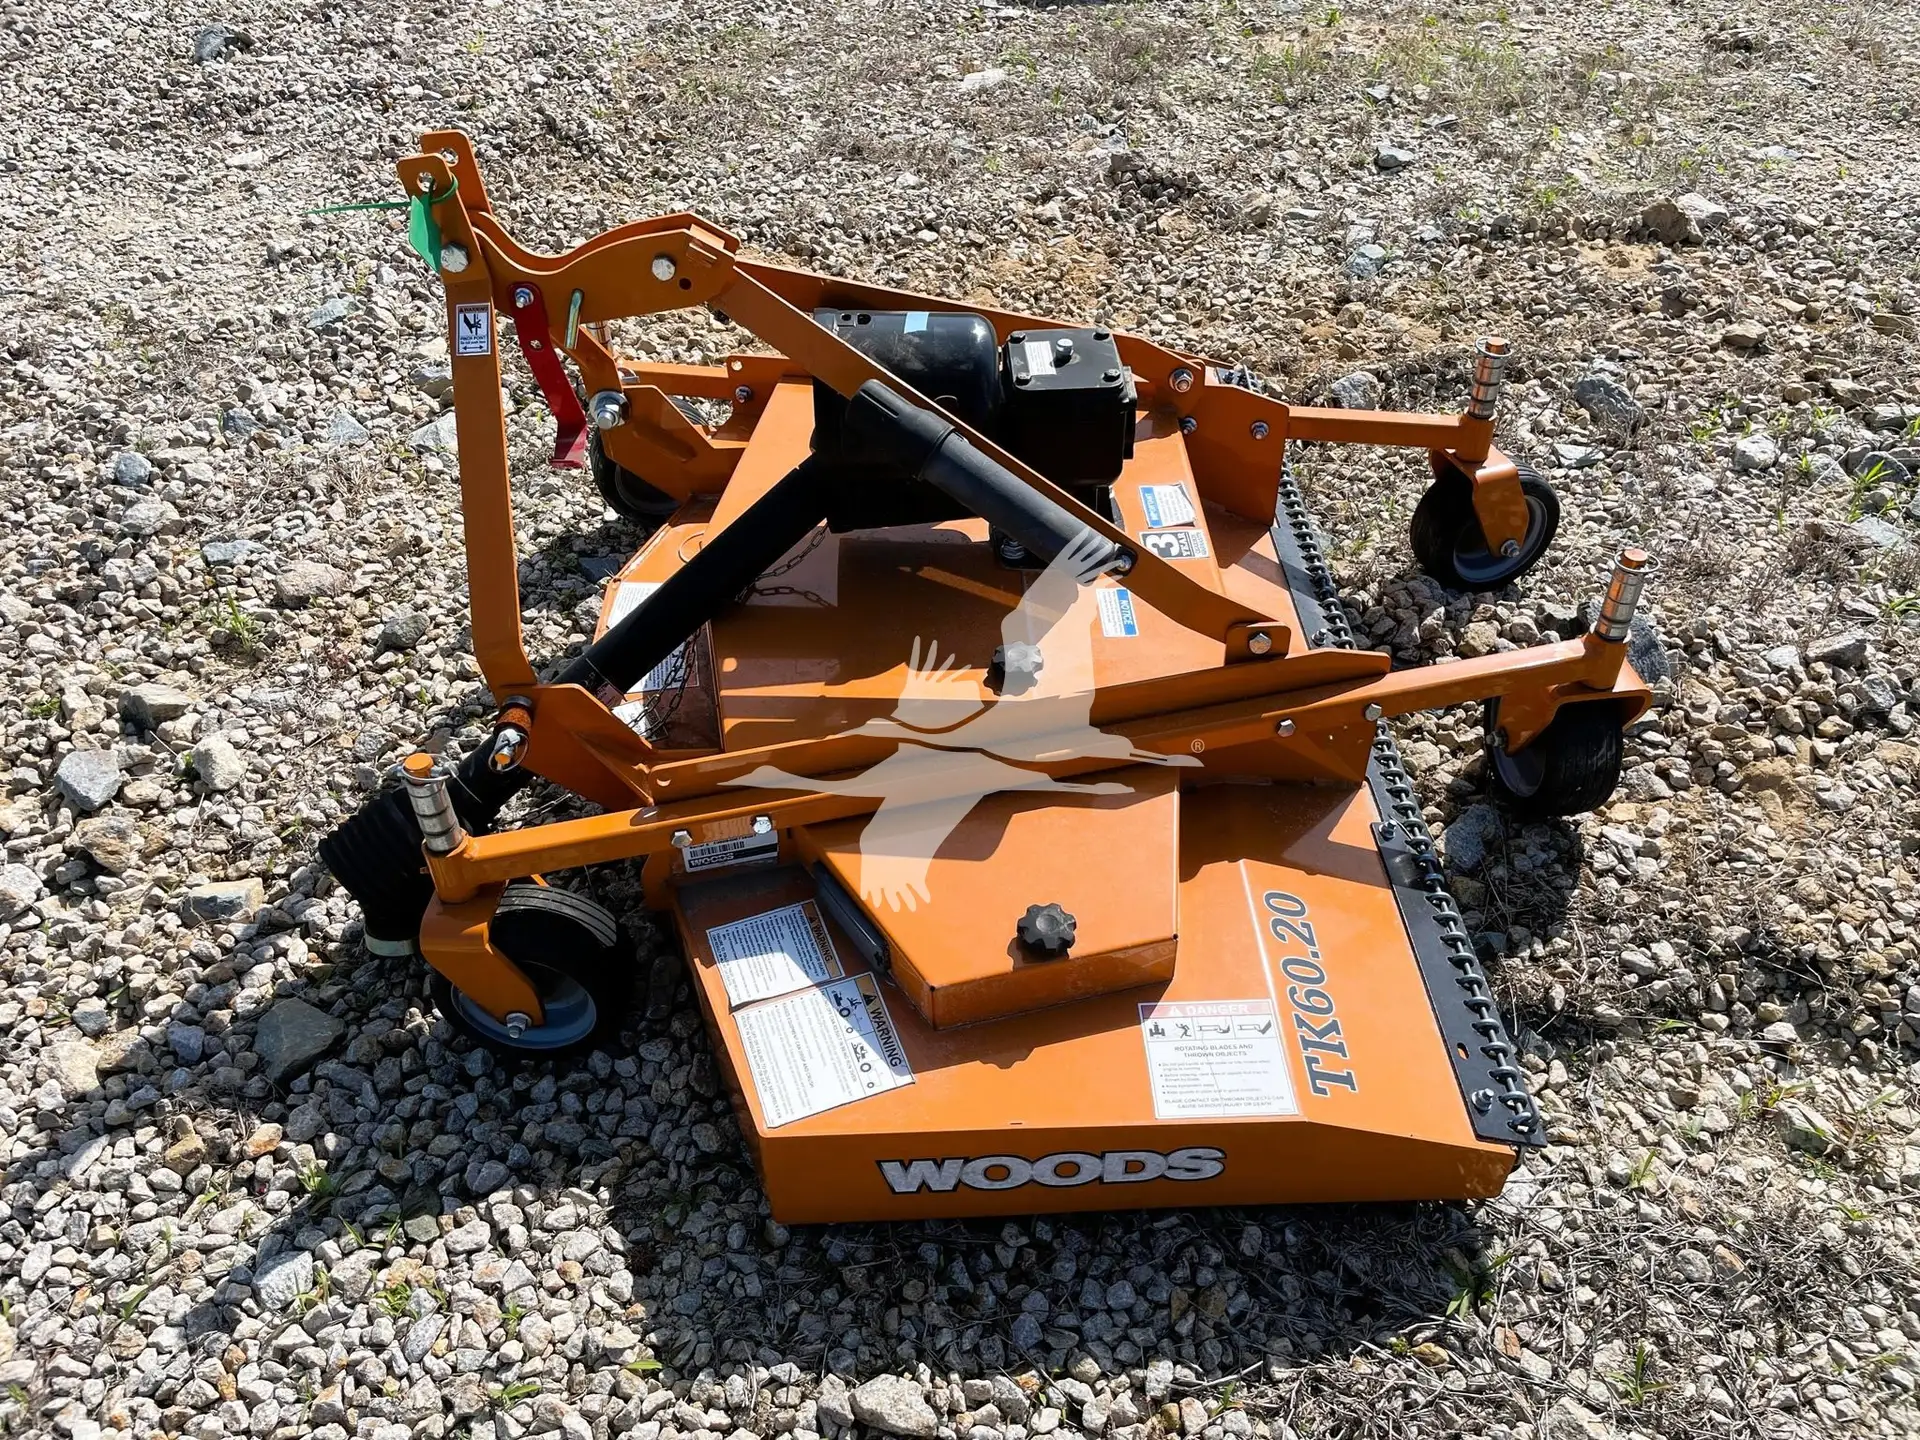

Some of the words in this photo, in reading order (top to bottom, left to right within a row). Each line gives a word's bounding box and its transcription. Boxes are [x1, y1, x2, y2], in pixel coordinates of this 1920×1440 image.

[1145, 533, 1180, 557] 3
[1119, 599, 1133, 625] NOTICE
[690, 852, 734, 866] WOODS
[811, 924, 833, 961] WARNING
[1185, 1004, 1250, 1015] DANGER
[1263, 890, 1359, 1098] TK60.20
[869, 1007, 902, 1067] WARNING
[875, 1146, 1227, 1194] WOODS
